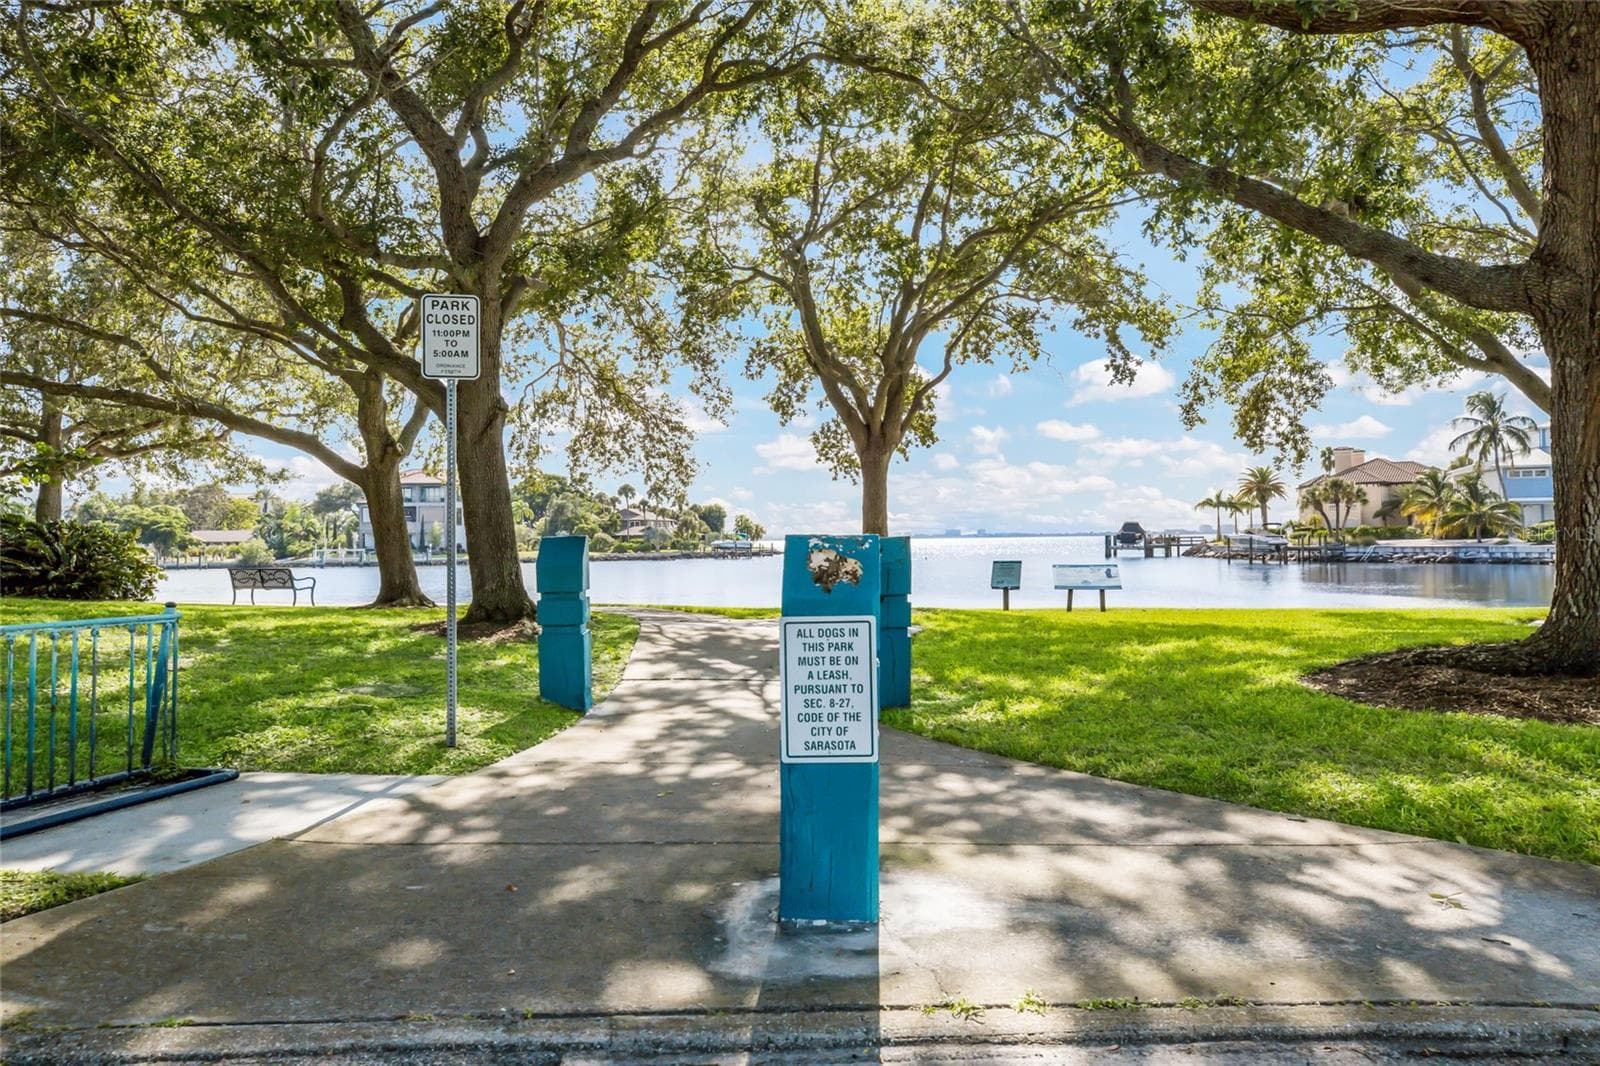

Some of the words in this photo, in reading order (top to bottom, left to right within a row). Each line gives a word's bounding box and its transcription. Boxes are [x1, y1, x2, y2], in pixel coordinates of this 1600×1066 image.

[431, 299, 470, 311] PARK
[426, 313, 476, 325] CLOSED
[432, 329, 470, 338] 11:00PM
[444, 339, 458, 347] TO
[433, 350, 469, 358] 5:00AM
[796, 628, 814, 639] ALL
[818, 628, 846, 638] DOGS
[848, 627, 859, 637] IN
[802, 642, 825, 652] THIS
[828, 642, 854, 652] PARK
[797, 656, 826, 666] MUST
[829, 656, 842, 666] BE
[844, 656, 859, 666] ON
[807, 670, 814, 680] A
[817, 670, 852, 681] LEASH,
[794, 684, 848, 695] PURSUANT
[851, 683, 864, 694] TO
[803, 698, 826, 709] SEC.
[829, 698, 854, 709] 8-27,
[797, 712, 824, 723] CODE
[827, 712, 840, 722] OF
[843, 712, 862, 722] THE
[810, 726, 833, 737] CITY
[836, 726, 849, 736] OF
[804, 740, 857, 751] SARASOTA
